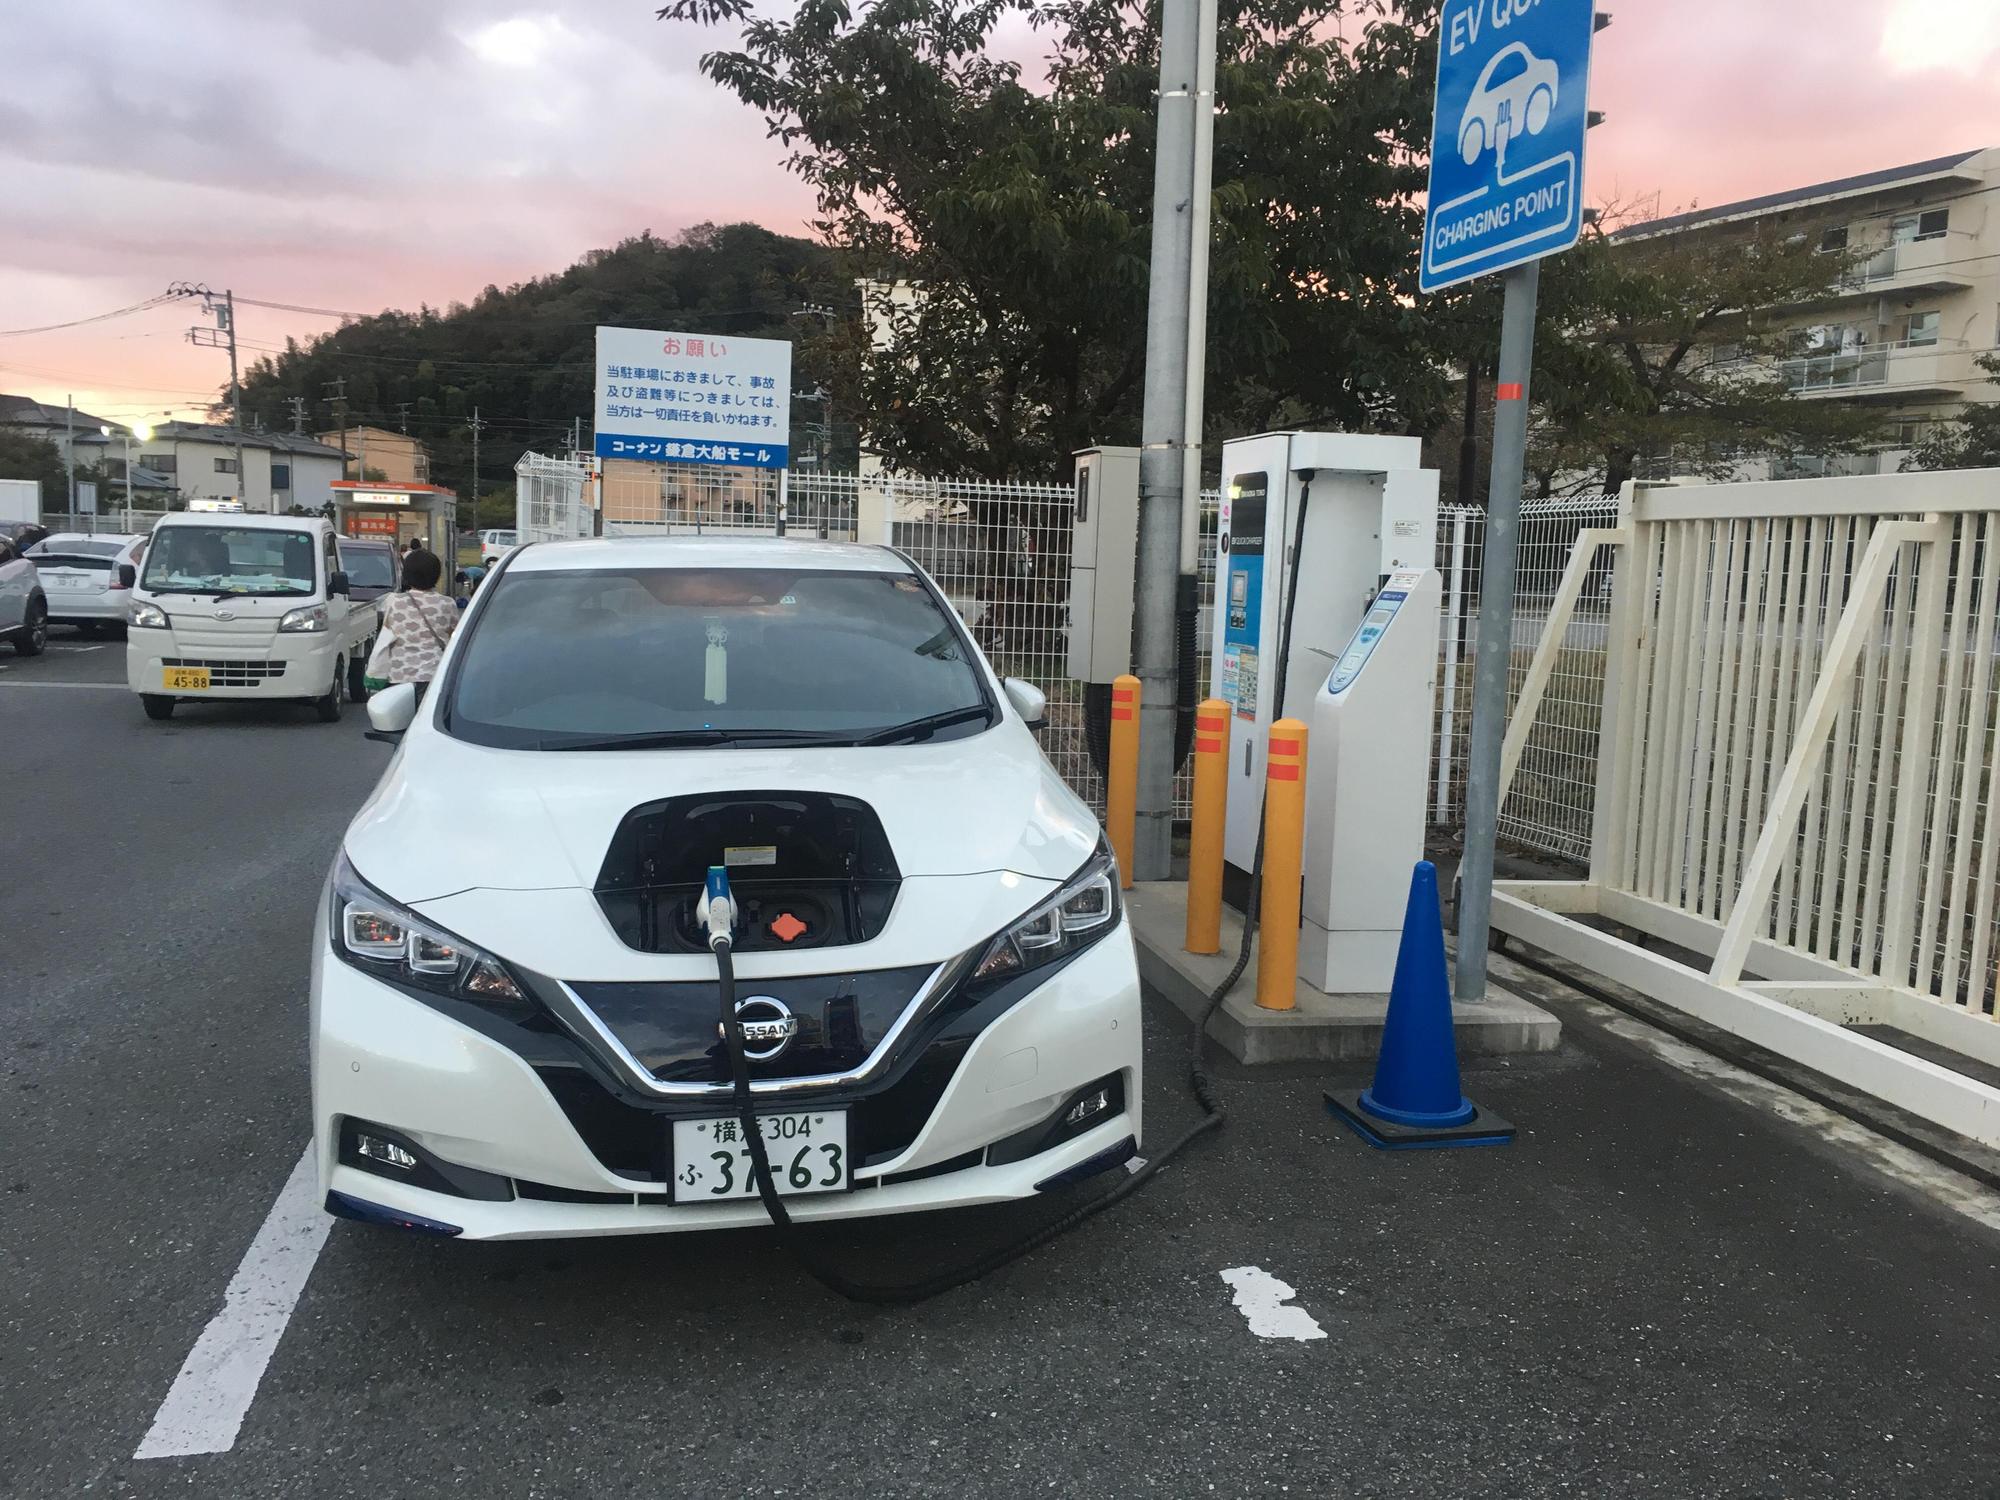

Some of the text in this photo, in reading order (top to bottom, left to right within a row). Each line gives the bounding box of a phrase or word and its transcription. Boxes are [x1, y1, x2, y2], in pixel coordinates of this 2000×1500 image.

[1450, 0, 1485, 56] EV
[1436, 180, 1566, 250] CHARGING POINT
[663, 337, 727, 358] お願い
[607, 365, 775, 390] 当駐車場におきまして、事故
[606, 385, 780, 409] 及び盗難等につきましては、
[606, 404, 778, 428] 当方は一切責任を負いかねます。
[613, 441, 771, 463] コーナン 鎌倉大船モール
[173, 676, 207, 688] 45-88
[767, 1115, 812, 1140] 304
[679, 1143, 842, 1194] ふ 37-63
